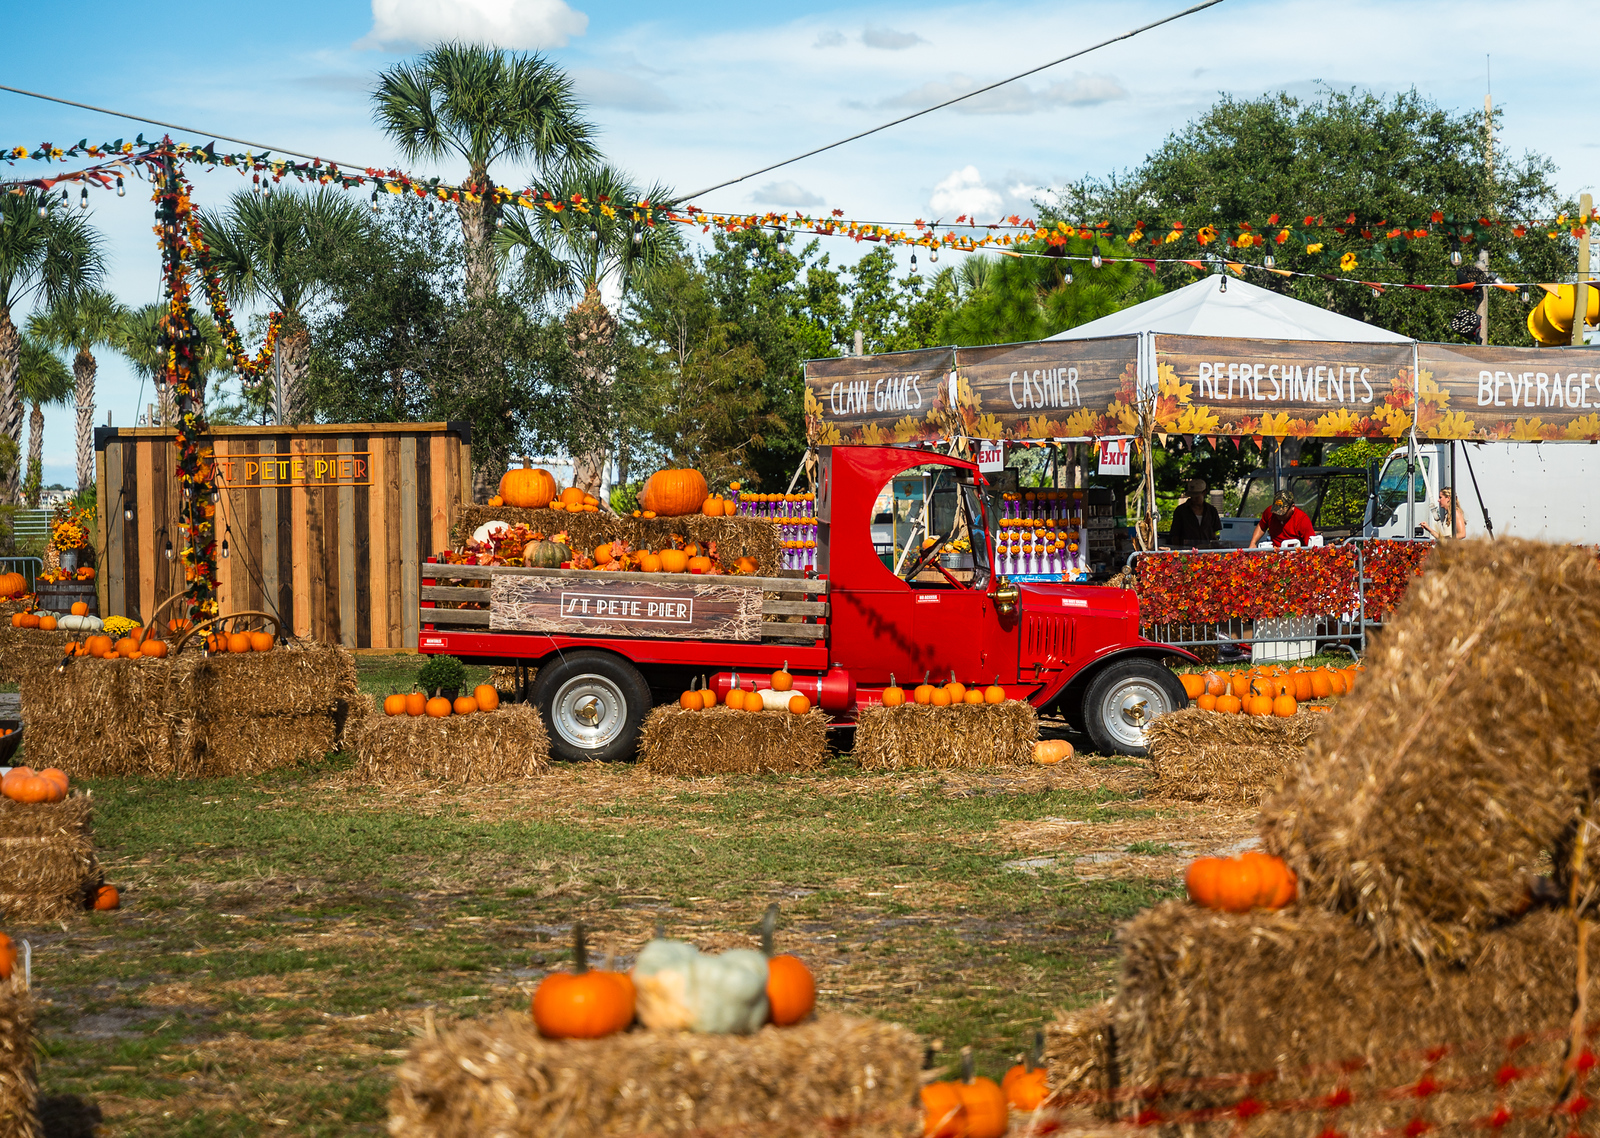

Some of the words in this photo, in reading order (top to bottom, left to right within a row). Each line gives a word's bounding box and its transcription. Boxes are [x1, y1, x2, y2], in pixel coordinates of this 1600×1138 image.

[1009, 367, 1080, 409] CASHIER
[1199, 362, 1374, 403] REFRESHMENTS
[831, 380, 868, 415] CLAW
[875, 375, 922, 411] GAMES
[979, 450, 1001, 463] EXIT
[1101, 452, 1128, 465] EXIT
[245, 461, 305, 481] PETE
[314, 459, 367, 479] PIER
[566, 598, 591, 614] ST.
[596, 599, 642, 616] PETE
[647, 602, 687, 618] PIER
